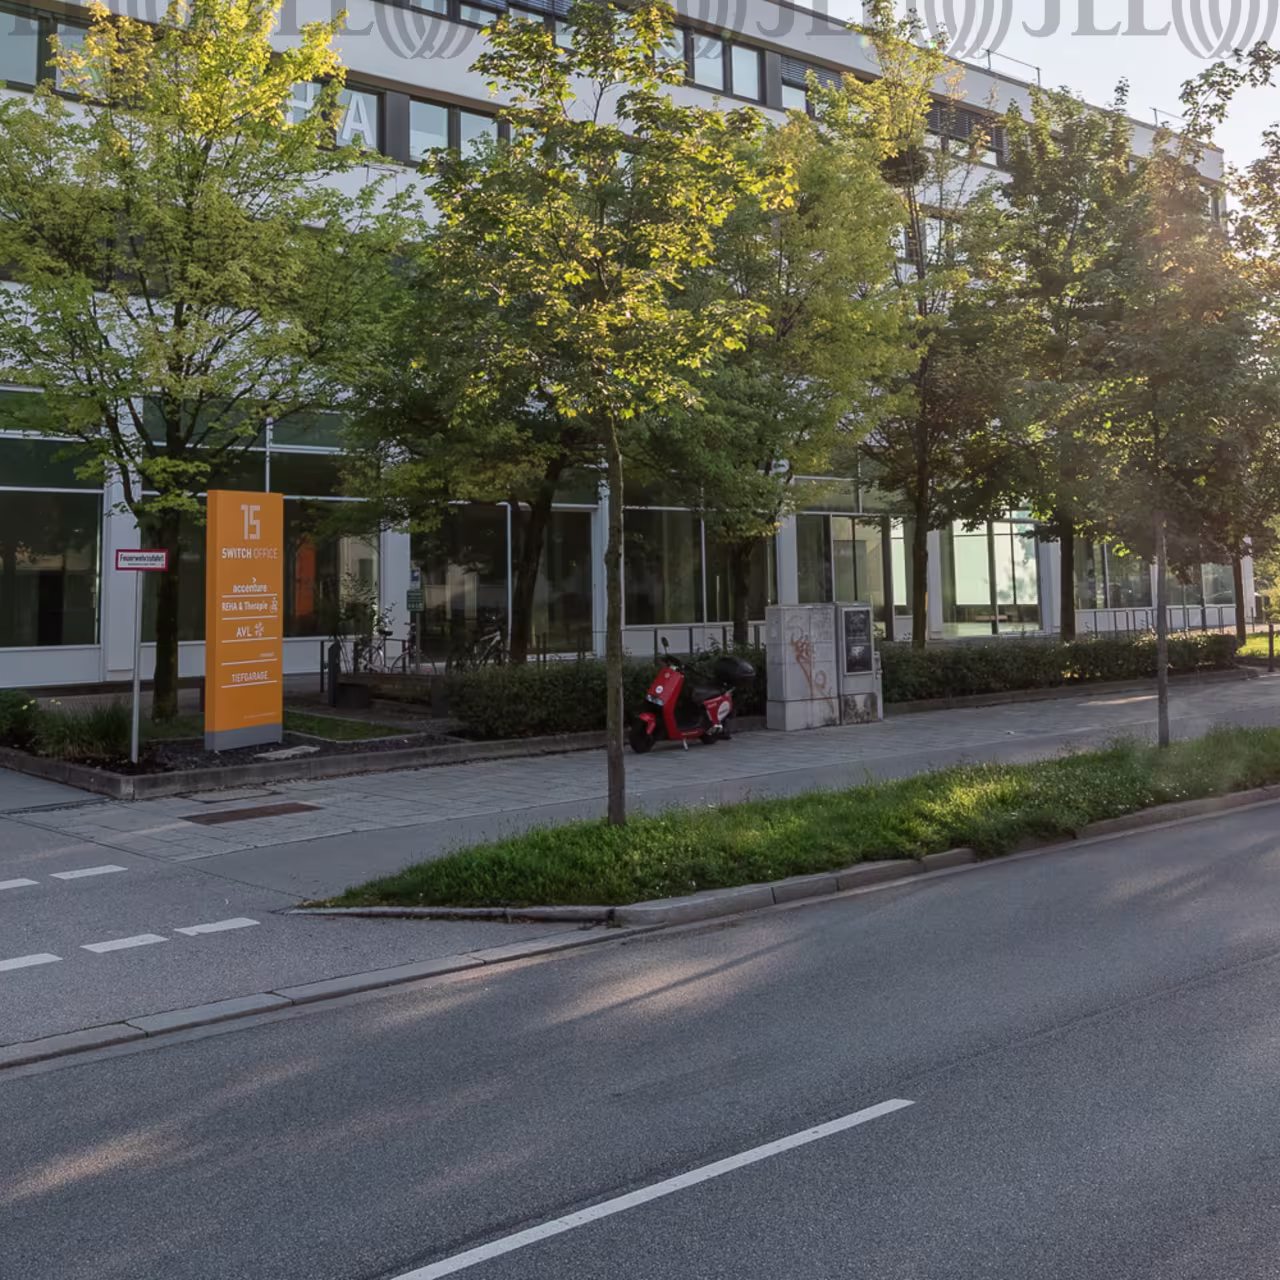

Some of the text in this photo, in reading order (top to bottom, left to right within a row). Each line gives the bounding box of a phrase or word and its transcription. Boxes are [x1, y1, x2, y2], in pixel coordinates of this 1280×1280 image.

[240, 504, 261, 540] 15
[222, 547, 252, 559] SWITCH
[232, 584, 268, 593] accenture
[236, 625, 253, 637] AVL
[232, 670, 269, 683] TIEFGARAGE
